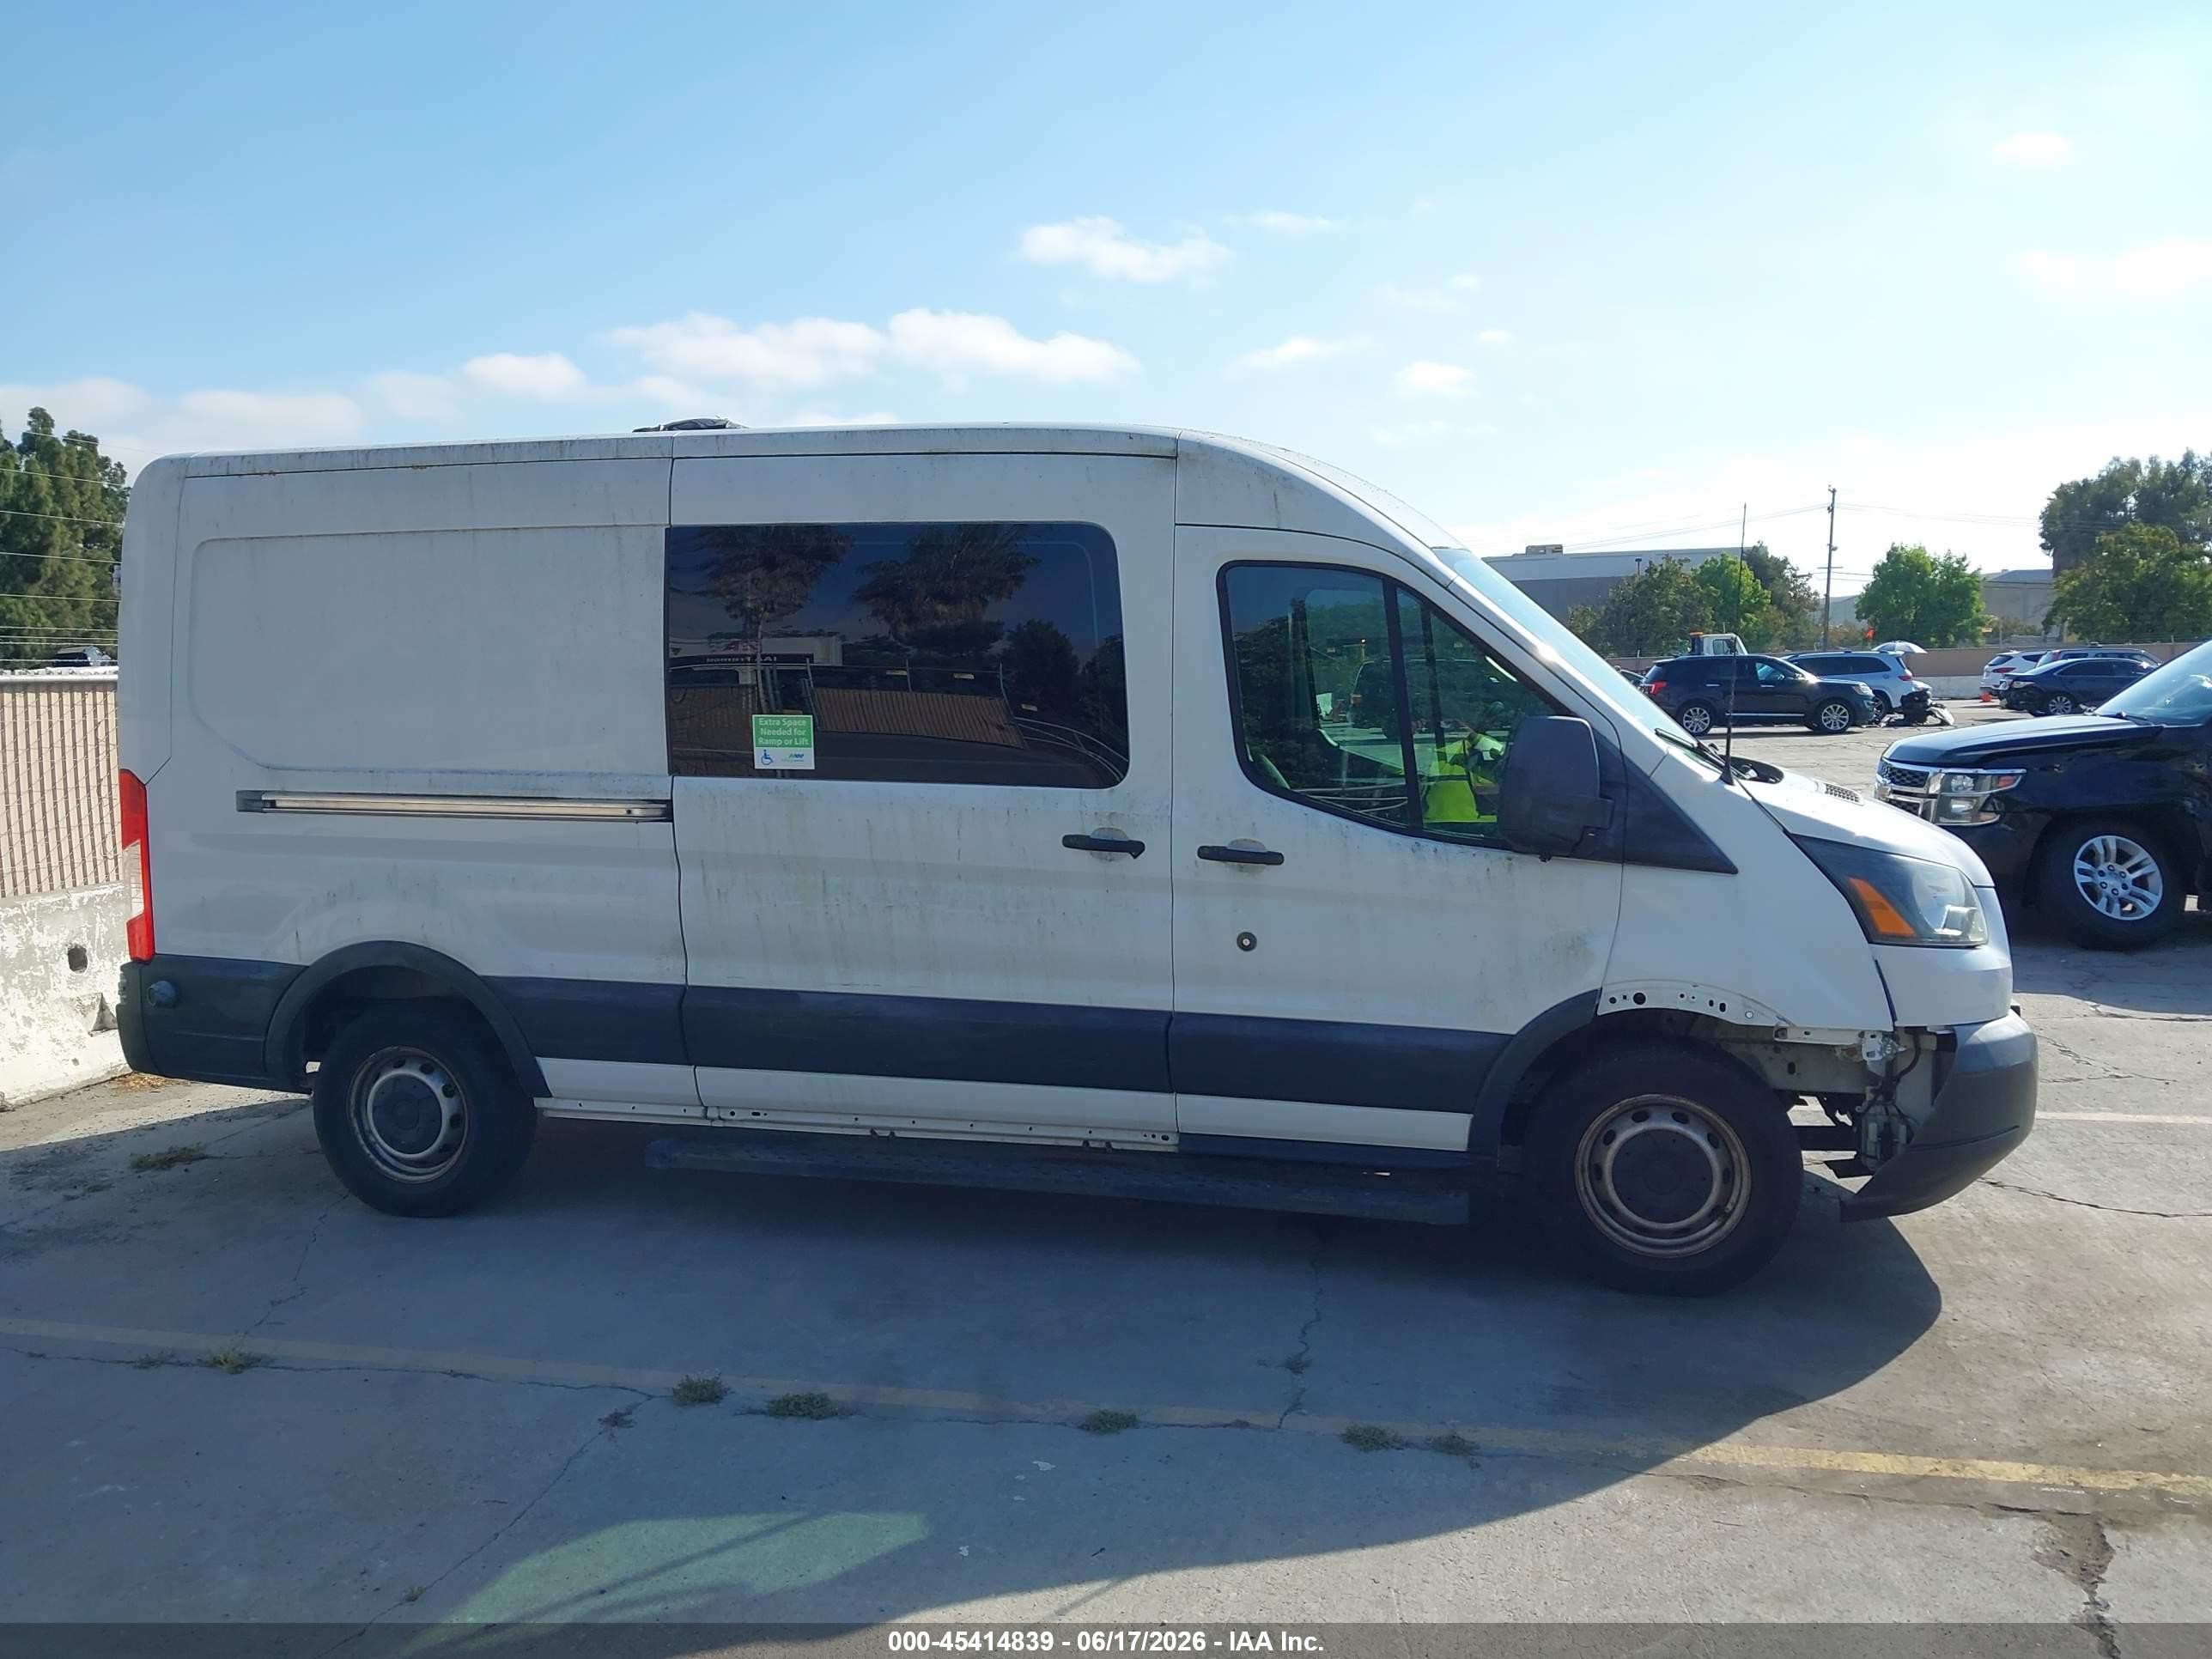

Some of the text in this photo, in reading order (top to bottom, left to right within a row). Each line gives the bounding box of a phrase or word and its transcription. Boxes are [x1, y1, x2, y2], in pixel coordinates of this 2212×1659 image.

[781, 718, 807, 727] Space
[760, 727, 807, 736] Needed for
[758, 737, 783, 746] Ramp
[793, 737, 809, 745] Lift
